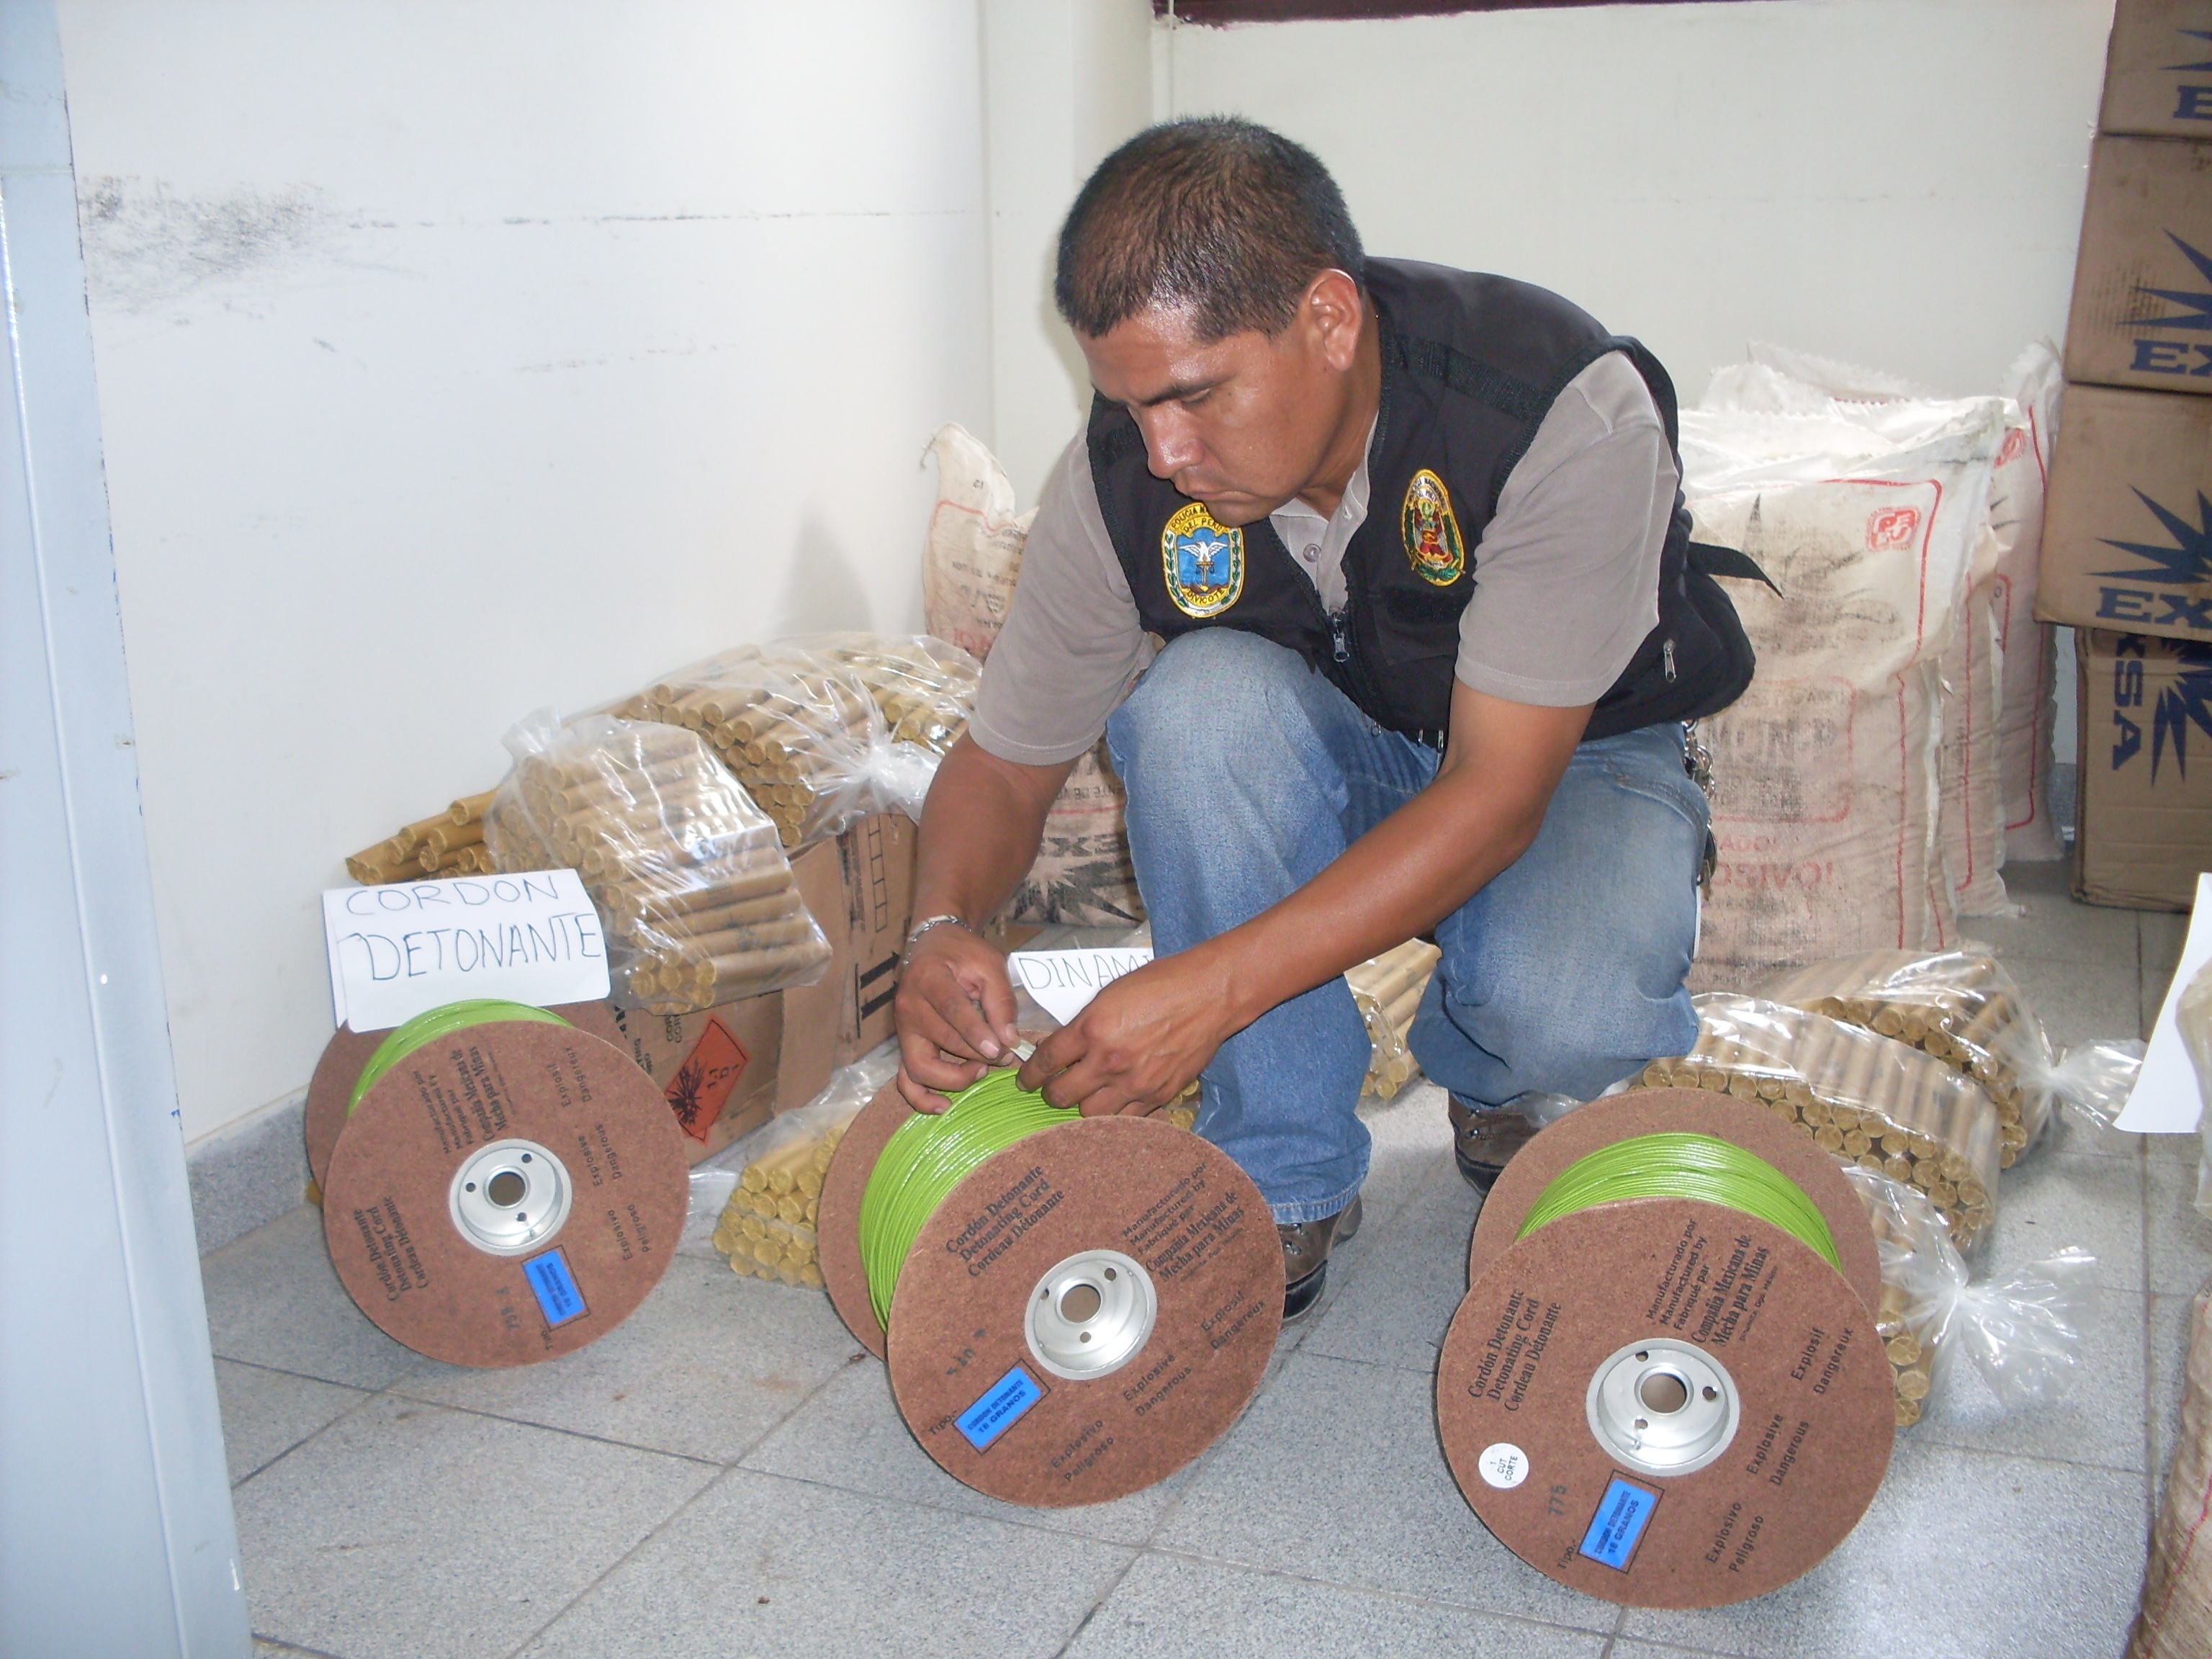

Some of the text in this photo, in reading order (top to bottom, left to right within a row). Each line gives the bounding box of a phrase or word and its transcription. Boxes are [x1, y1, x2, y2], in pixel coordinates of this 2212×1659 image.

[1172, 507, 1197, 529] POLICIA
[1183, 520, 1197, 533] DEL
[346, 875, 559, 916] CORDON
[337, 912, 601, 981] DETONANTE
[1018, 953, 1151, 989] DINAM
[469, 1046, 485, 1076] Minas
[480, 1076, 500, 1099] para
[547, 1063, 572, 1107] Explosif
[565, 1046, 593, 1103] Dangereux
[490, 1100, 510, 1131] Mecha
[578, 1135, 603, 1187] Explosive
[595, 1123, 623, 1180] Dangerous
[1191, 1161, 1208, 1179] por
[354, 1208, 382, 1262] Detonante
[607, 1209, 633, 1261] Explosivo
[627, 1204, 652, 1253] Peligroso
[945, 1165, 1044, 1253] Cordón Detonante
[959, 1178, 1051, 1262] Detonating Cord
[968, 1190, 1065, 1277] Cordeau Détonante
[1130, 1179, 1206, 1246] Manufactured by
[1185, 1201, 1227, 1238] Mexicana
[1226, 1190, 1238, 1205] de
[366, 1206, 413, 1292] Detonating Cord
[405, 1246, 429, 1289] Cordeau
[1159, 1251, 1194, 1282] Mecha
[1192, 1231, 1217, 1258] para
[1212, 1205, 1245, 1236] Minas
[1646, 1218, 1699, 1320] Manufacturado por
[1659, 1236, 1708, 1326] Manufactured by
[1673, 1263, 1711, 1331] Fabriqué par
[1691, 1234, 1753, 1344] Compañía Mexicana de
[1711, 1246, 1771, 1347] Mecha para Minas
[1201, 1290, 1245, 1332] Explosif
[1210, 1299, 1267, 1350] Dangereux
[1467, 1287, 1525, 1398] Cordón Detonante
[1485, 1298, 1540, 1403] Detonating Cord
[1503, 1302, 1562, 1411] Cordeau Détonante
[1791, 1326, 1825, 1381] Explosif
[1812, 1328, 1853, 1395] Dangereux
[1123, 1353, 1176, 1402] Explosive
[1134, 1366, 1192, 1418] Dangerous
[990, 1390, 1027, 1424] GRANOS
[1051, 1419, 1104, 1469] Explosivo
[1064, 1436, 1115, 1483] Peligroso
[1497, 1457, 1508, 1474] CUT
[1504, 1455, 1519, 1481] CORTE
[1746, 1413, 1784, 1475] Explosive
[1770, 1419, 1809, 1486] Dangerous
[1614, 1498, 1640, 1541] GRANOS
[1705, 1502, 1742, 1564] Explosivo
[1729, 1514, 1764, 1573] Peligroso
